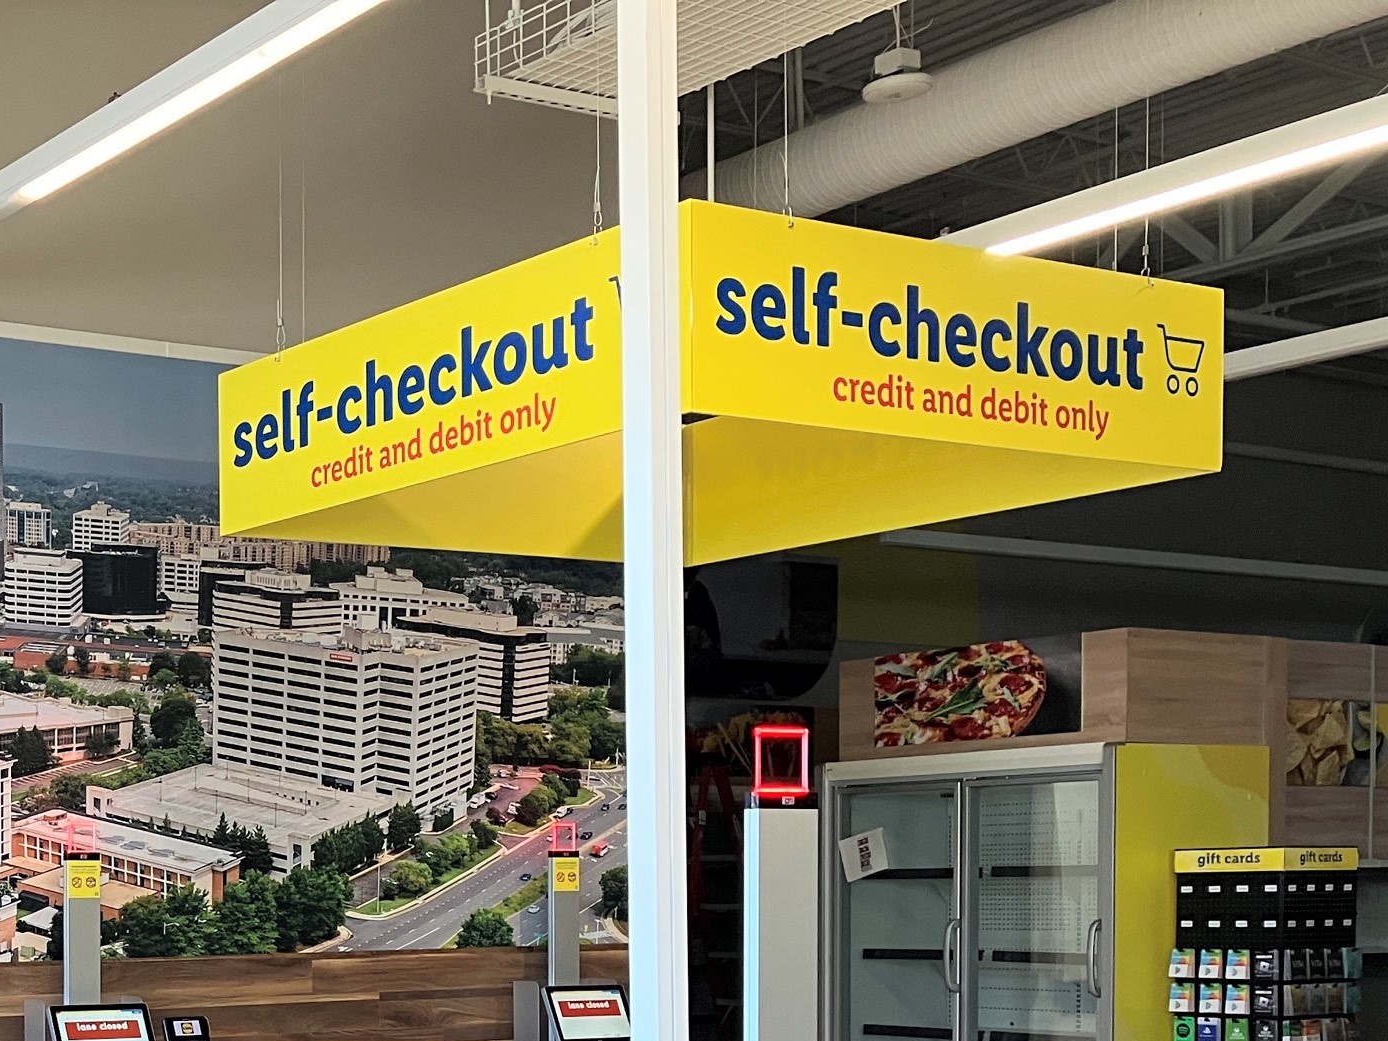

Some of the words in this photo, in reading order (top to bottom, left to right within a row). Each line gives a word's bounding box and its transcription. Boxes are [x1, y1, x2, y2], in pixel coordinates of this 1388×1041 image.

[716, 266, 1144, 390] self-checkout
[234, 297, 595, 468] self-checkout
[831, 374, 916, 412] credit
[922, 386, 975, 417] and
[980, 388, 1049, 427] debit
[1055, 402, 1110, 441] only
[310, 445, 374, 489] credit
[379, 428, 423, 470] and
[428, 412, 494, 456] debit
[499, 393, 558, 436] only
[1197, 852, 1221, 867] gift
[1224, 852, 1261, 865] cards
[1299, 851, 1317, 866] gift
[1318, 851, 1343, 863] cards
[567, 1002, 585, 1010] lane
[586, 1001, 610, 1009] closed
[76, 1022, 97, 1032] lane
[99, 1021, 129, 1031] closed
